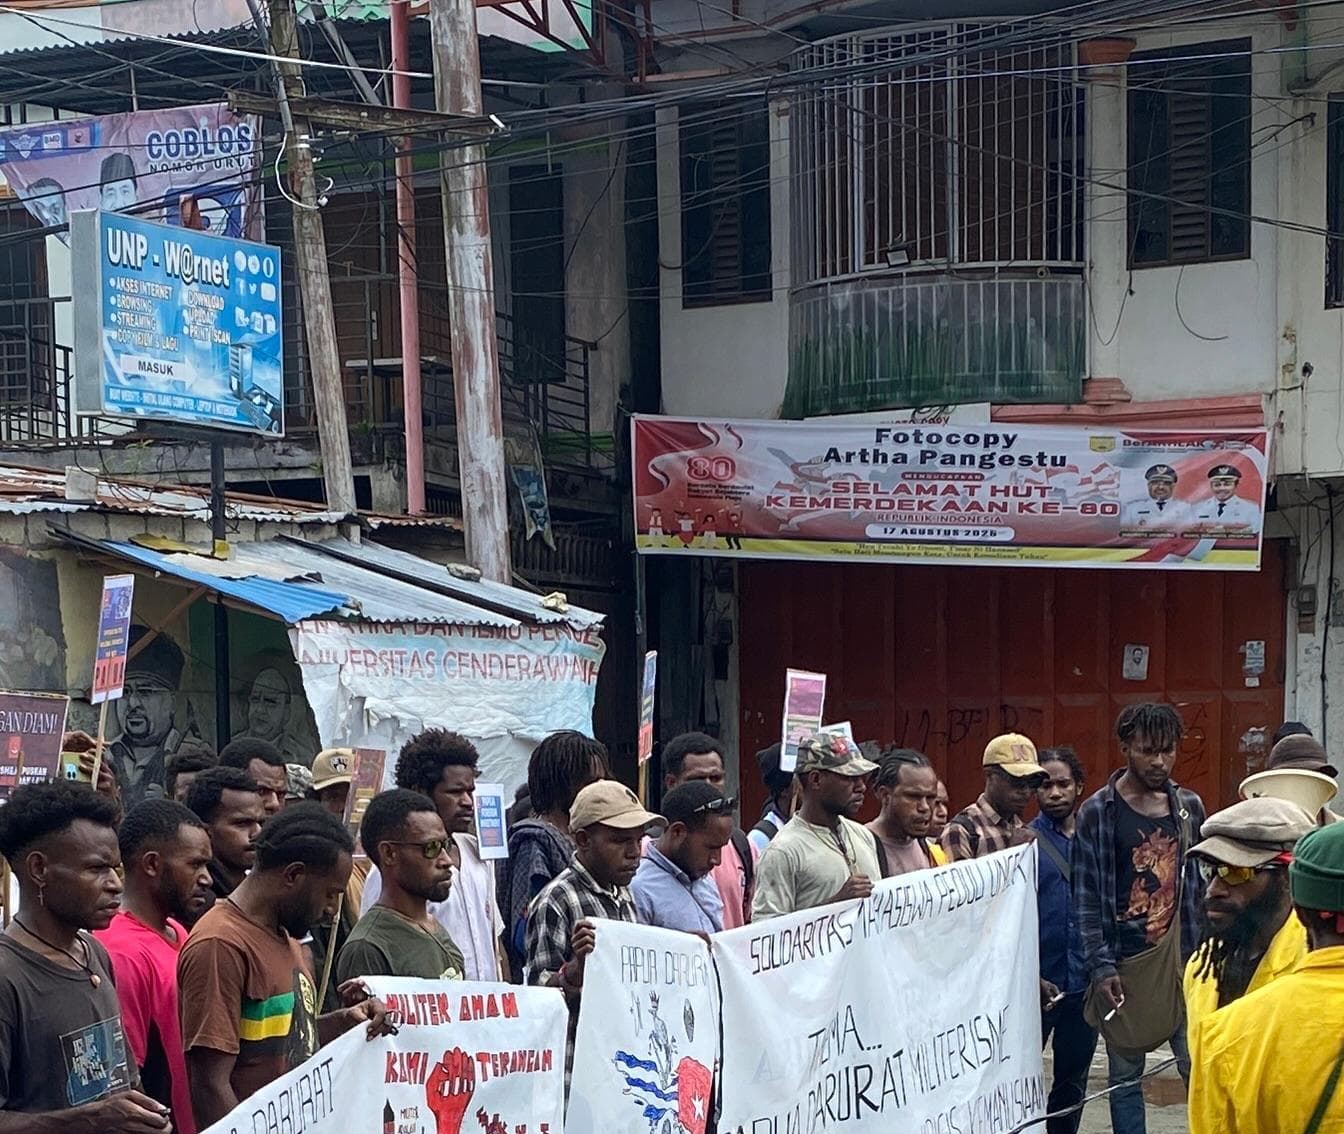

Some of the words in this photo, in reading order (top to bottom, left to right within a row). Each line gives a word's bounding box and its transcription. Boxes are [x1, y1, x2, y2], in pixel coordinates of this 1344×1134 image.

[147, 122, 254, 161] COBLOS
[150, 160, 205, 175] NOMOR
[214, 154, 260, 171] URUT
[107, 227, 148, 268] UNP
[164, 240, 230, 287] W@rnet
[116, 276, 140, 294] AKSES
[139, 280, 173, 300] INTERNET
[138, 361, 174, 376] MASUK
[876, 428, 1018, 448] Fotocopy
[687, 456, 736, 481] 80
[824, 447, 908, 464] Artha
[920, 450, 1067, 470] Pangestu
[904, 472, 983, 482] MENGUCAPKAN
[832, 481, 981, 497] SELAMAT
[990, 486, 1052, 498] HUT
[766, 495, 1007, 514] KEMERDEKAAN
[1017, 502, 1120, 516] KE-80
[877, 513, 933, 523] REPUBLIK
[935, 515, 1002, 525] INDONESIA
[883, 527, 895, 536] 17
[901, 527, 960, 538] AGUSTUS
[964, 529, 998, 538] 2025
[23, 712, 58, 736] DIAM!
[751, 911, 853, 975] SOLIDARITAS
[620, 945, 658, 985] PAPUA
[385, 992, 452, 1026] MILITER
[384, 1051, 430, 1085] KAMI
